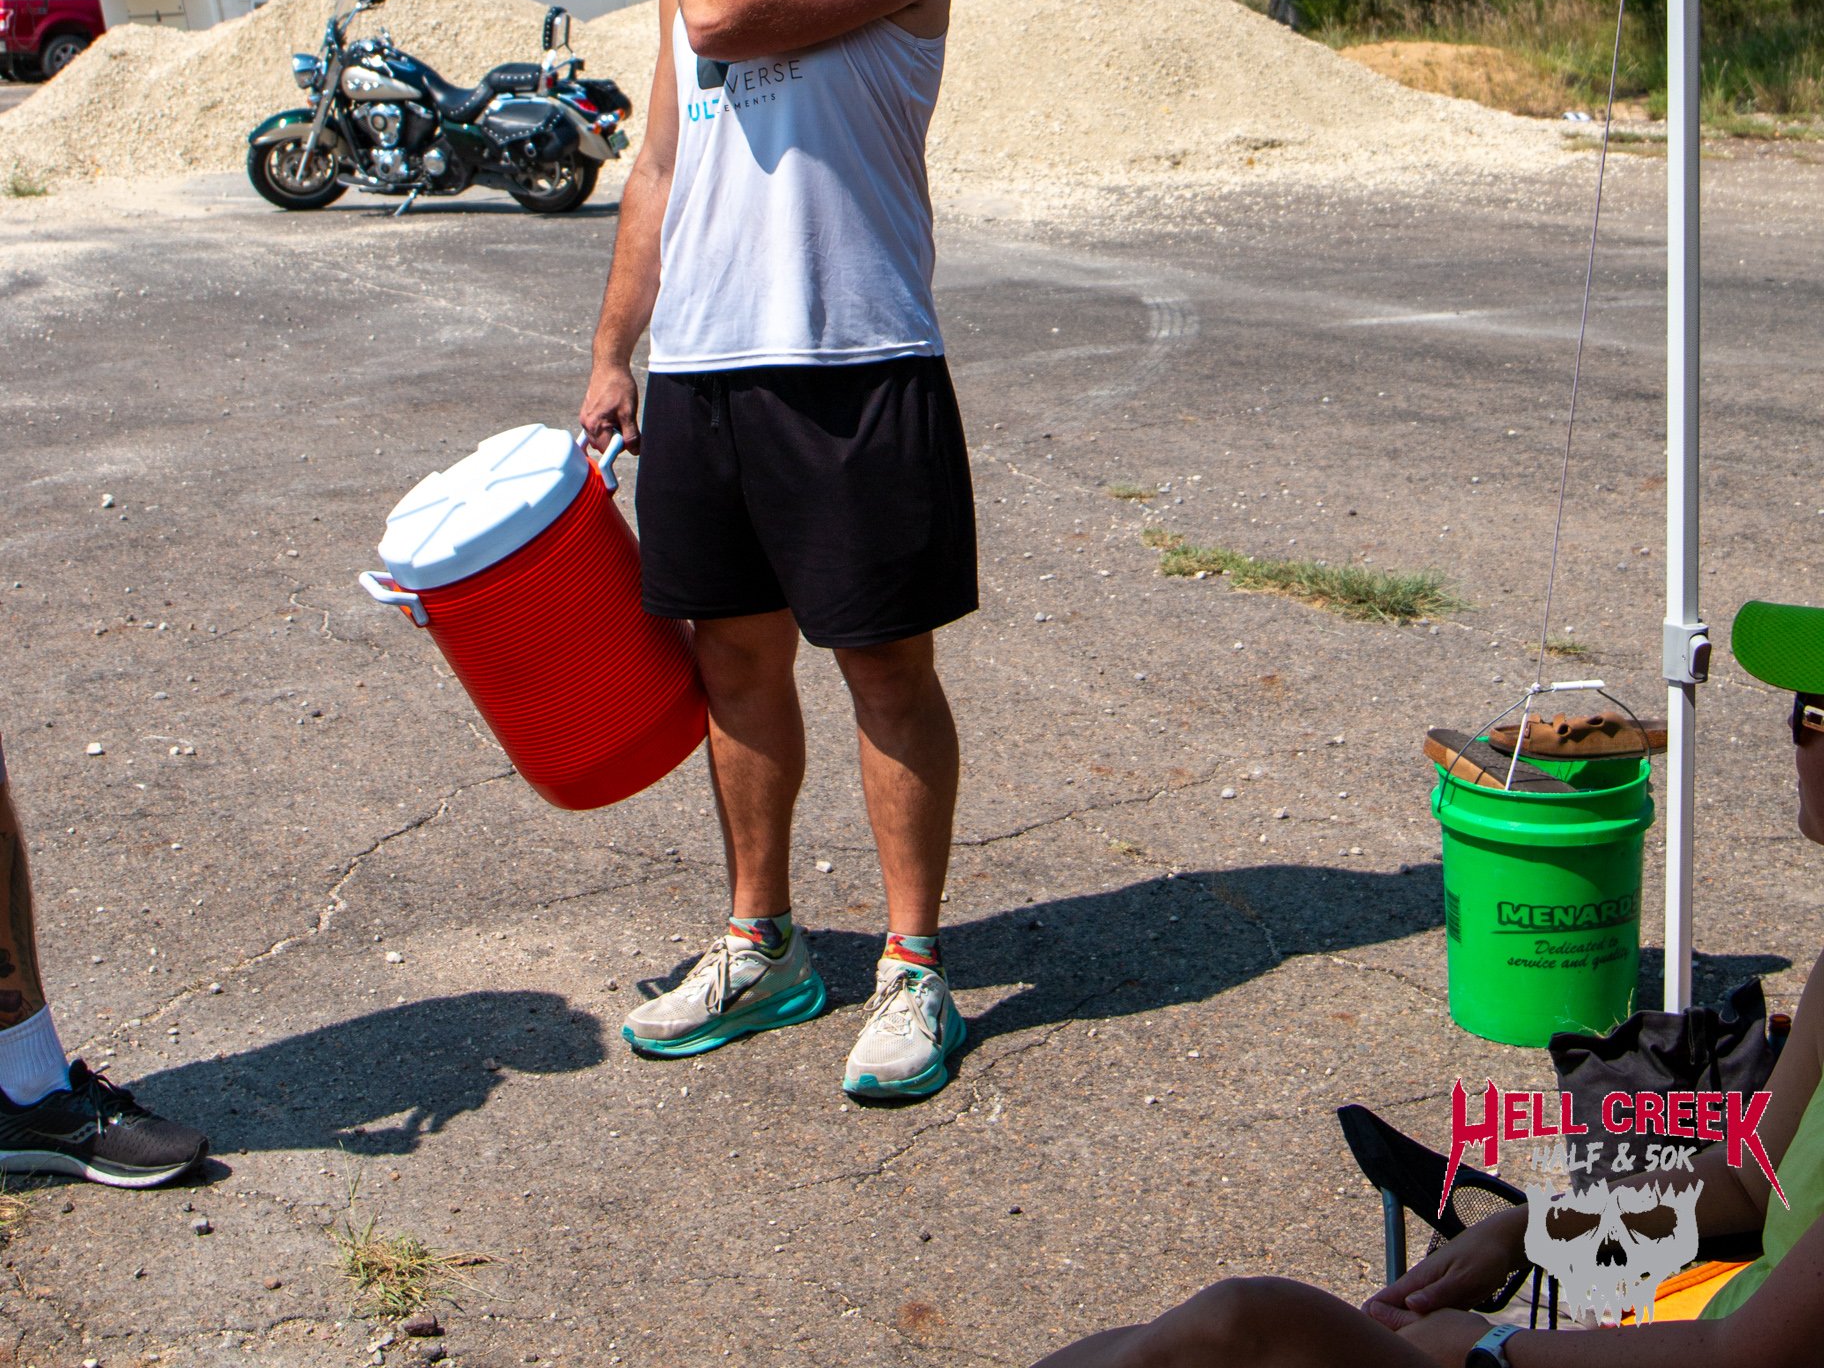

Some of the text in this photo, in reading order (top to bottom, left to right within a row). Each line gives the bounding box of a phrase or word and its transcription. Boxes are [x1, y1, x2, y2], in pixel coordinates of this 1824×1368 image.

[716, 93, 776, 113] EMENTS
[1534, 936, 1619, 956] Dedicated to
[1507, 945, 1630, 971] service and quality
